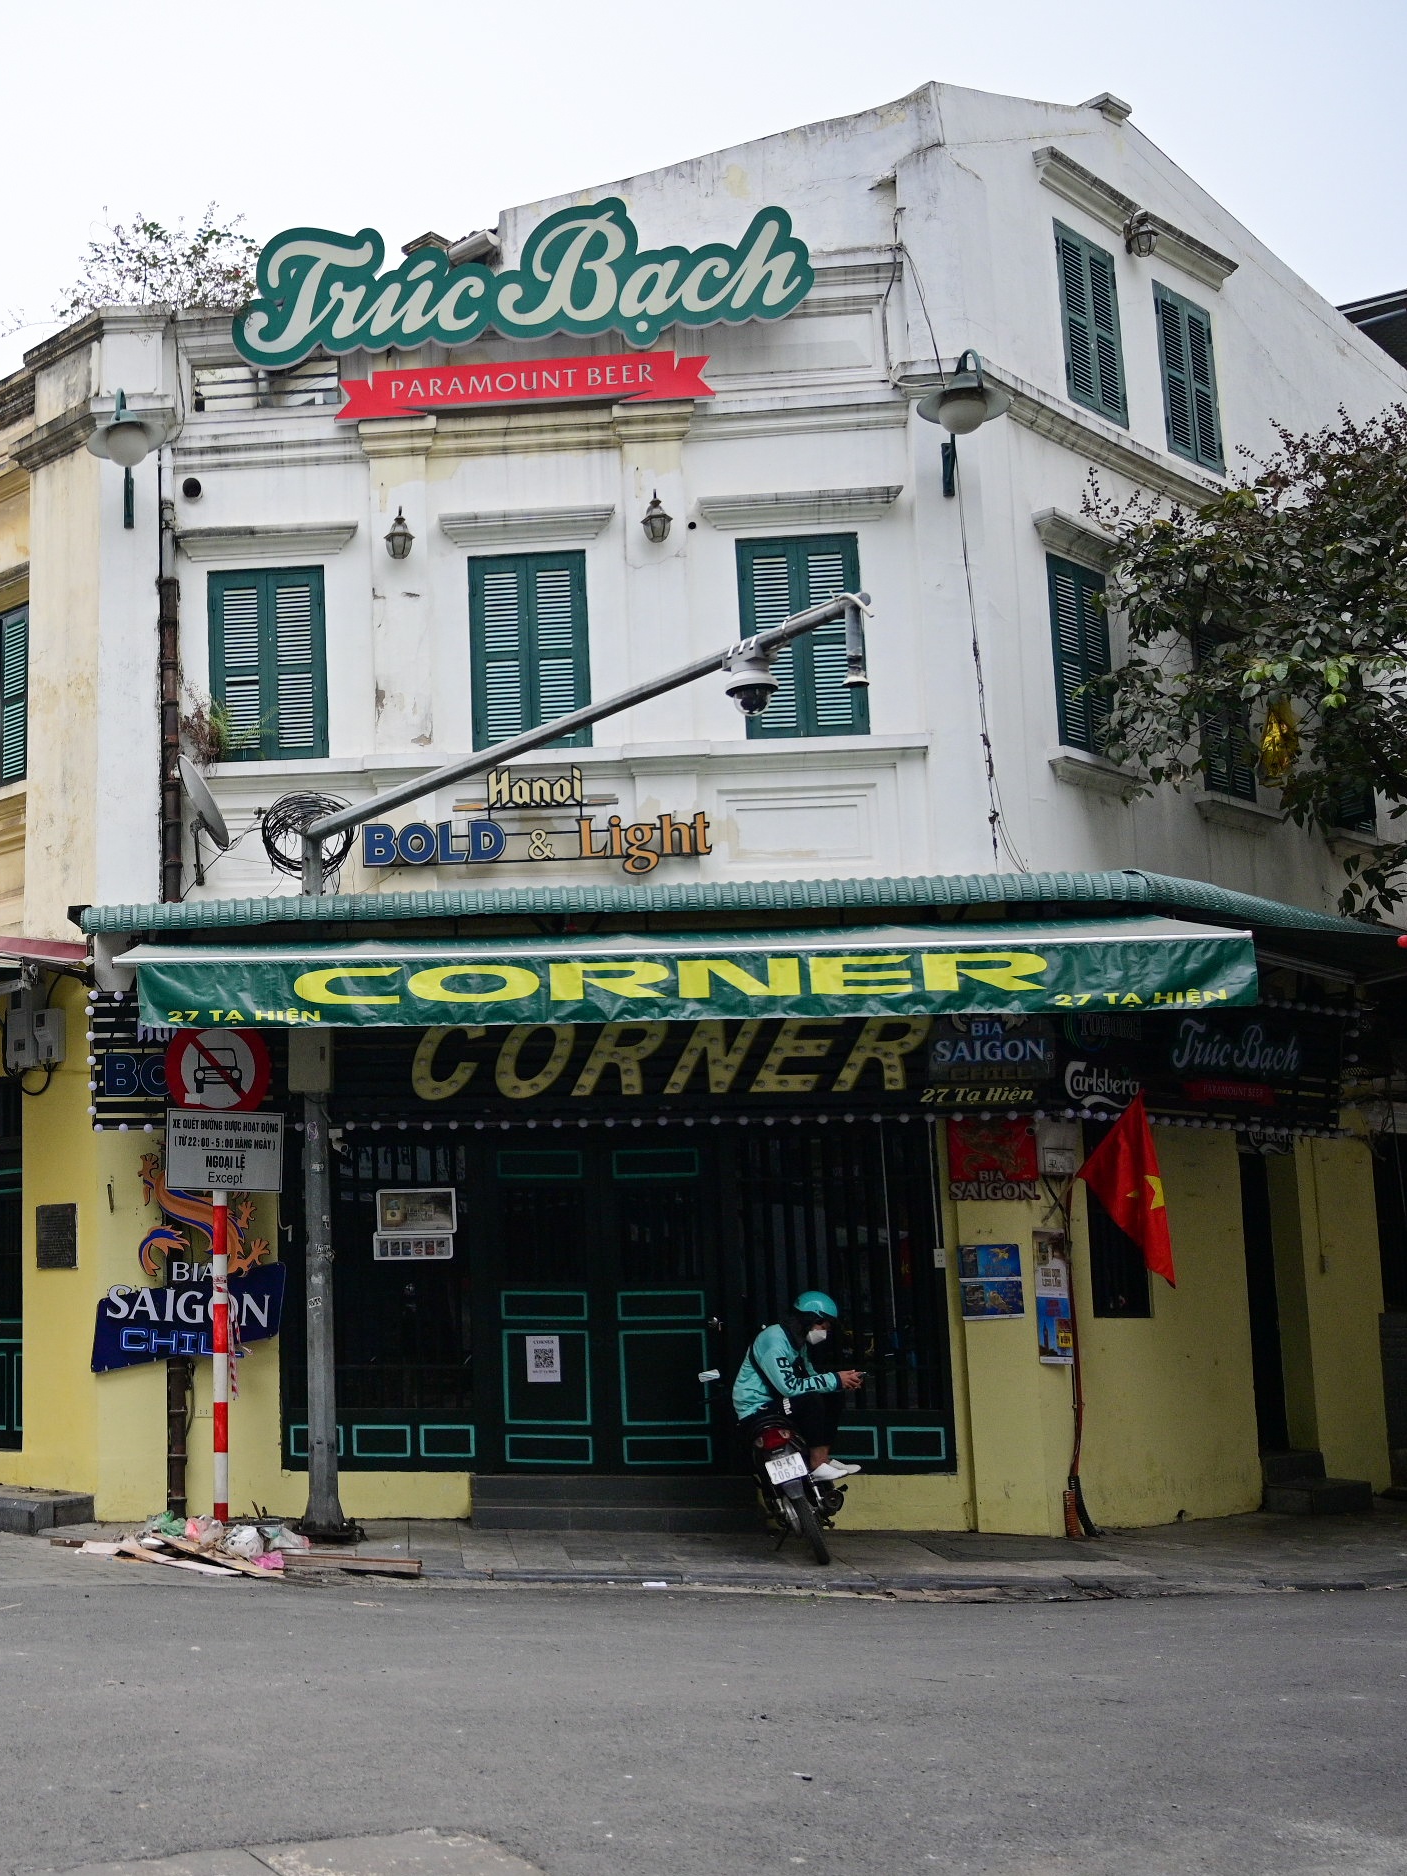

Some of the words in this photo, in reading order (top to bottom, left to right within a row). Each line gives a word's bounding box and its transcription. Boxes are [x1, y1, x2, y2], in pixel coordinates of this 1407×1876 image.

[244, 239, 485, 355] Trúc
[496, 209, 802, 335] Bạch
[390, 368, 578, 399] PARAMOUNT
[586, 363, 655, 386] BEER
[488, 765, 583, 807] Hanoi
[362, 819, 506, 867] BOLD
[527, 828, 556, 861] &
[576, 810, 713, 875] Light
[293, 951, 1049, 1006] CORNER
[1054, 994, 1092, 1006] 27
[1103, 992, 1144, 1008] TẠ
[1153, 989, 1228, 1007] HIỆN
[167, 1010, 200, 1022] 27
[209, 1009, 245, 1024] TẠ
[255, 1008, 321, 1025] HIỆN
[1078, 1013, 1142, 1041] TUBORG
[970, 1021, 1004, 1037] BIA
[411, 1014, 931, 1100] CORNER
[935, 1039, 1045, 1063] SAIGON
[1172, 1018, 1233, 1069] Trúc
[1233, 1023, 1300, 1077] Bạch
[104, 1054, 170, 1096] BO
[1064, 1060, 1141, 1100] Carlsberg
[920, 1088, 951, 1103] 27
[954, 1087, 982, 1105] Tạ
[984, 1086, 1034, 1105] Hiện
[172, 1118, 181, 1129] XE
[205, 1155, 233, 1171] NGOẠI
[235, 1154, 246, 1171] LỆ
[208, 1171, 243, 1186] Except
[979, 1169, 1006, 1181] BIA
[950, 1181, 1036, 1200] SAIGON
[172, 1261, 214, 1282] BIA
[106, 1284, 272, 1328] SAIGON
[771, 1455, 797, 1471] 19-K1
